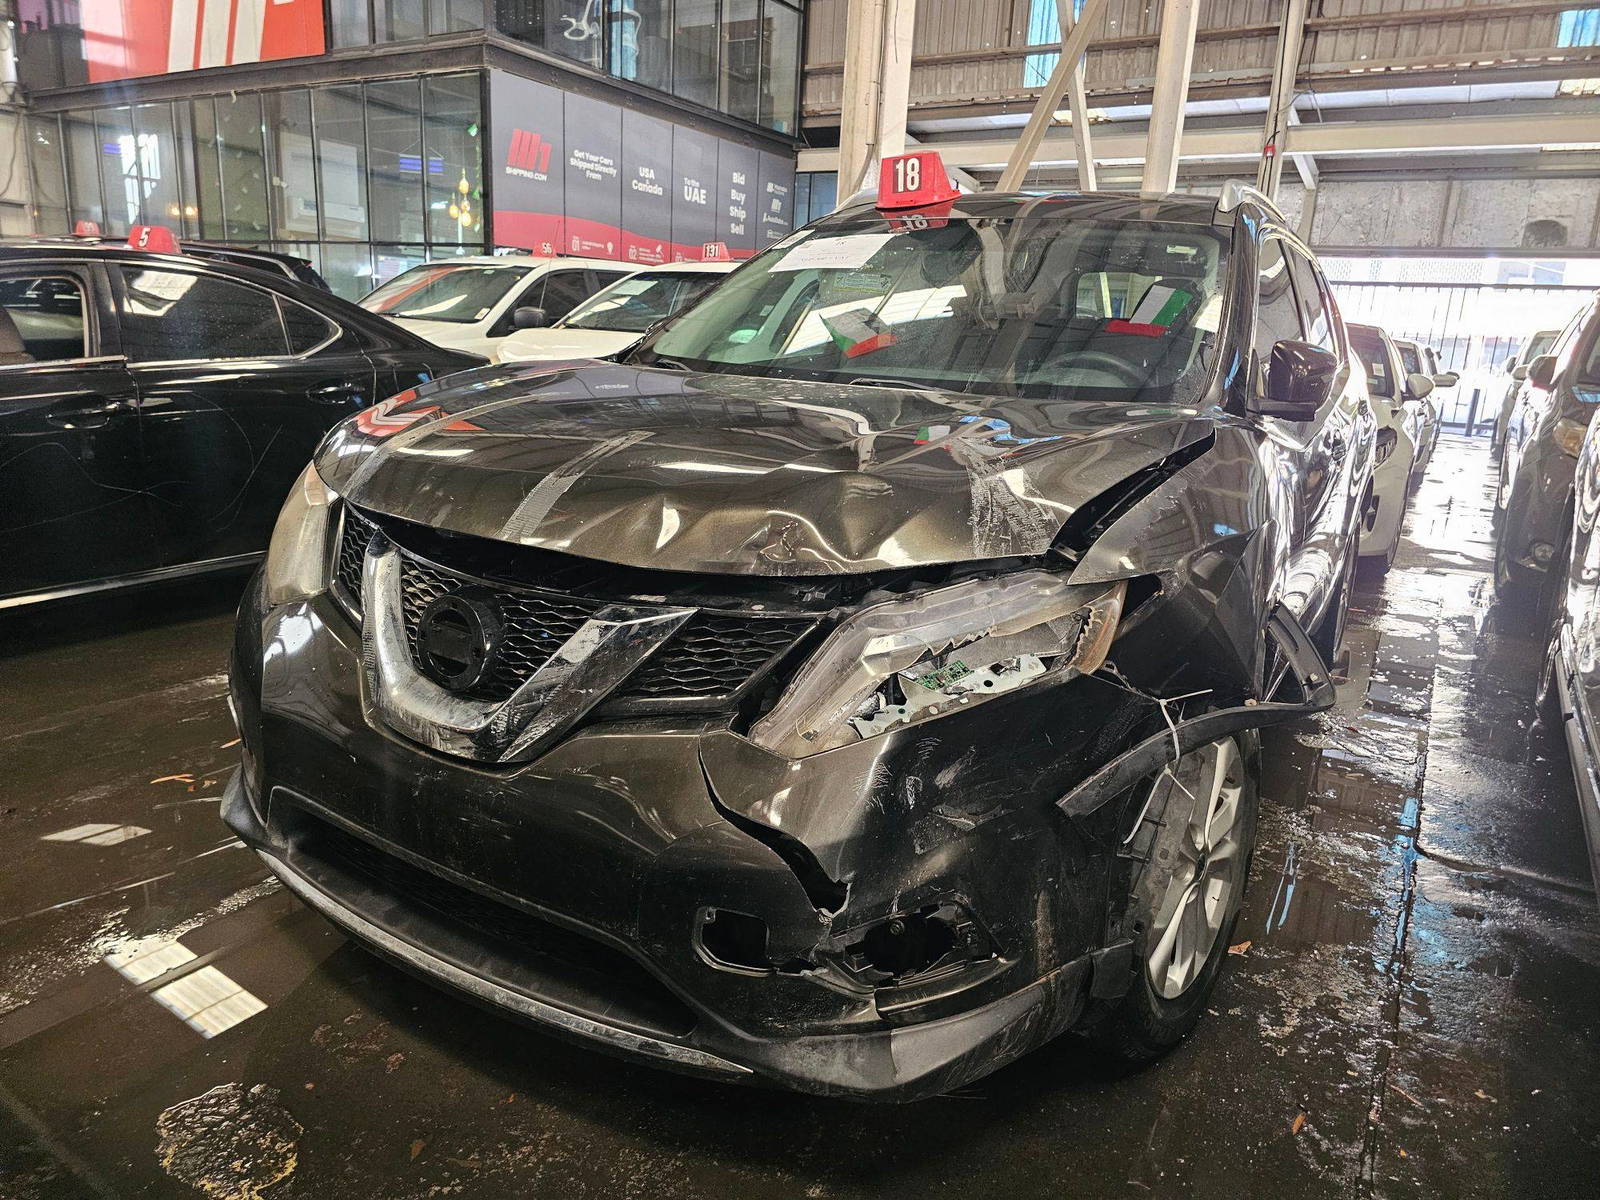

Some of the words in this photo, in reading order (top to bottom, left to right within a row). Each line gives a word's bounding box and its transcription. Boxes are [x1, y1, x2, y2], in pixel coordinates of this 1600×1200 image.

[569, 157, 594, 170] Shipped
[574, 149, 585, 160] Get
[585, 152, 599, 163] Your
[599, 156, 613, 166] Cars
[585, 169, 602, 181] From
[639, 166, 655, 180] USA
[732, 171, 745, 185] Bid
[896, 157, 920, 193] 18
[632, 179, 663, 196] Canada
[684, 177, 691, 186] To
[691, 179, 700, 188] the
[684, 185, 707, 205] UAE
[731, 188, 746, 205] Buy
[729, 205, 746, 222] Ship
[138, 227, 151, 247] 5
[730, 223, 745, 236] Sell
[705, 244, 720, 258] 131
